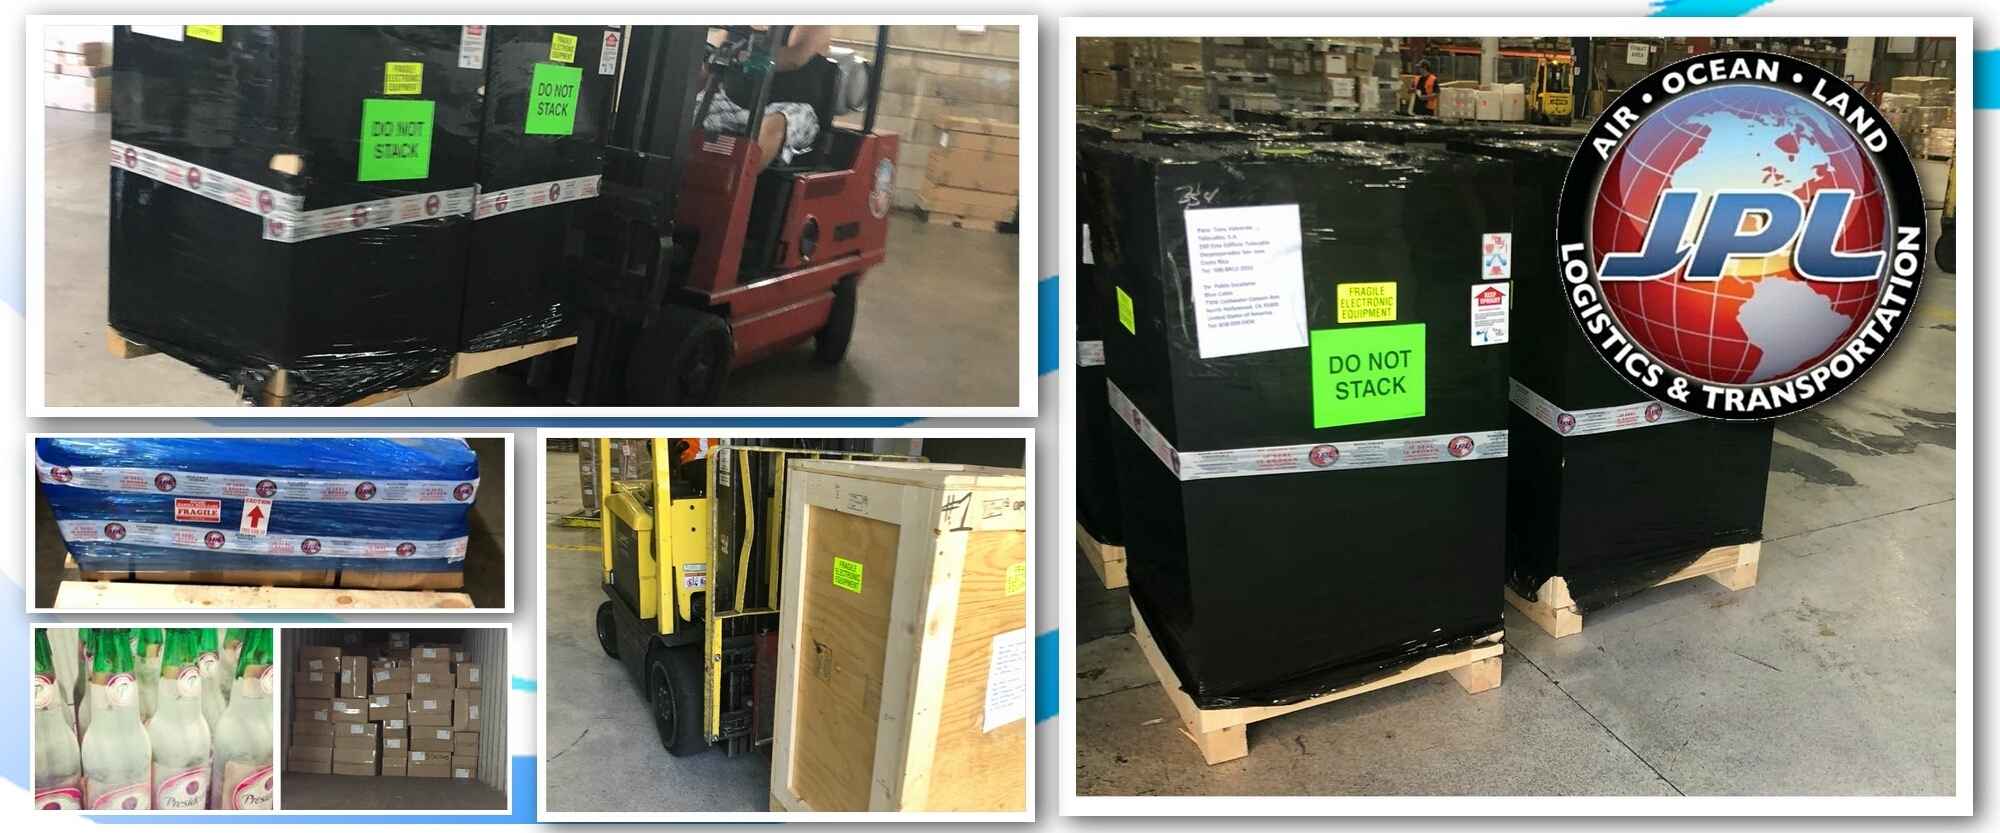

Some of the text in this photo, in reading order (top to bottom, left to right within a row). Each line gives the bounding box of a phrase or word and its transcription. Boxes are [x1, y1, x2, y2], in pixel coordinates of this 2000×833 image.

[538, 82, 574, 98] DO NOT
[537, 102, 568, 117] STACK
[371, 121, 394, 137] DO
[374, 143, 418, 159] STACK
[1349, 286, 1385, 296] FRAGILE
[1340, 296, 1393, 309] ELECTRONIC
[1342, 307, 1392, 319] EQUIPMENT
[1328, 349, 1412, 375] DO NOT
[1335, 375, 1406, 400] STACK
[177, 508, 217, 516] FRAGILE
